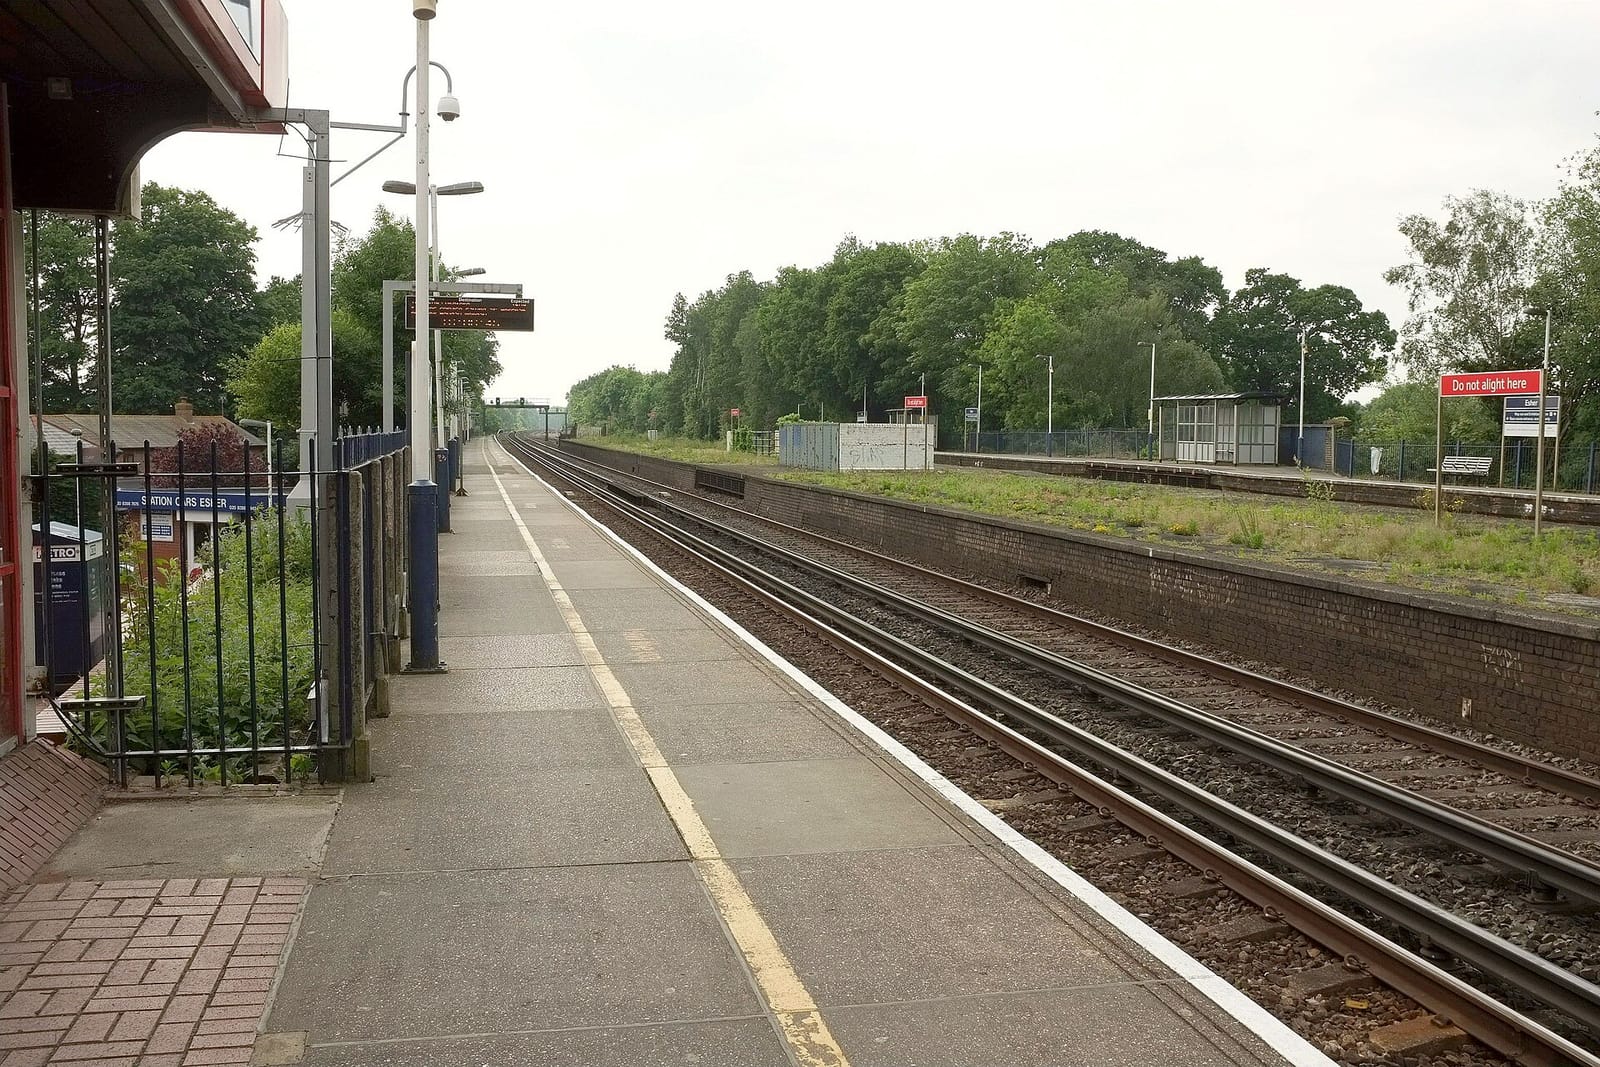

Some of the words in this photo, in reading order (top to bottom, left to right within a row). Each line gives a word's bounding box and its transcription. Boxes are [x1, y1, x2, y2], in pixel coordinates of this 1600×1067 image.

[1452, 379, 1464, 391] Do
[1466, 379, 1479, 391] not
[1482, 377, 1505, 392] alight
[1507, 377, 1527, 390] here
[141, 495, 173, 506] SATION
[37, 548, 75, 558] TRO
